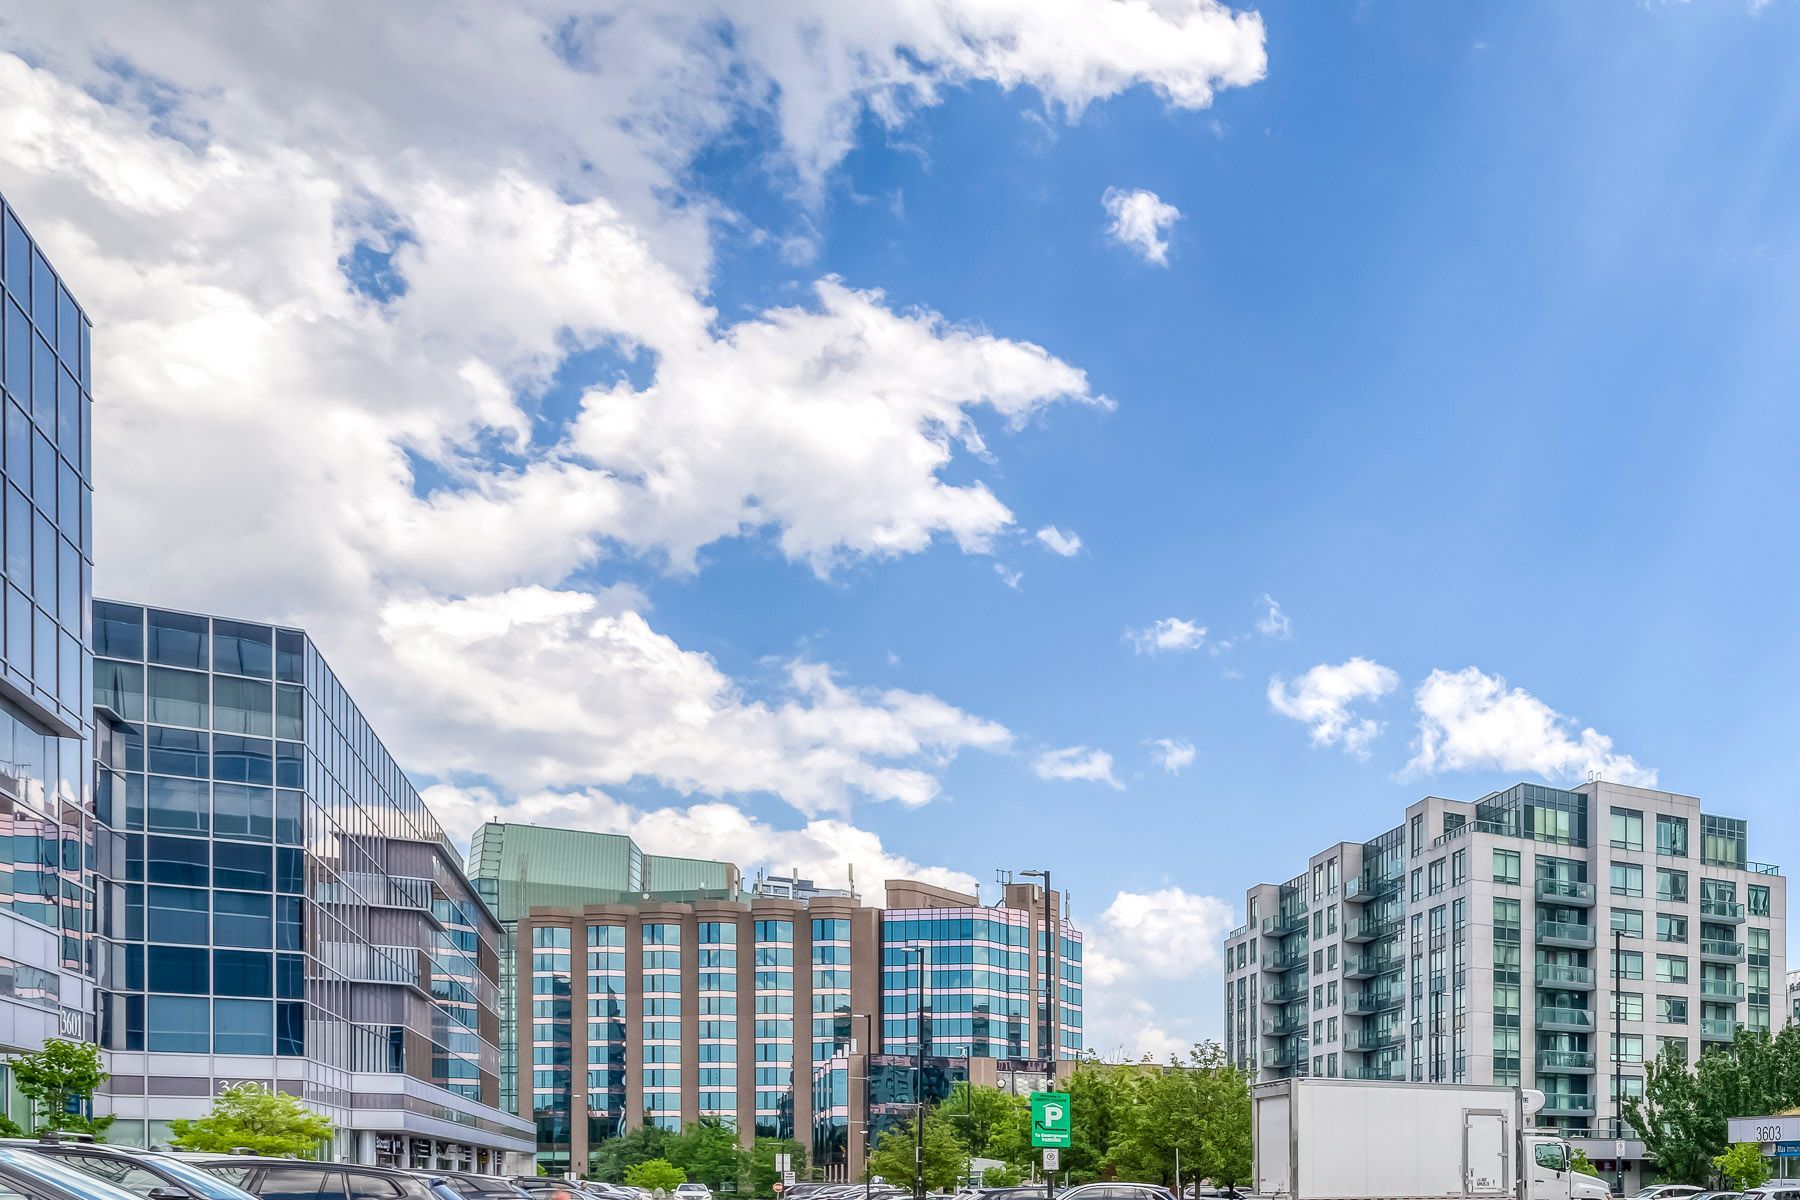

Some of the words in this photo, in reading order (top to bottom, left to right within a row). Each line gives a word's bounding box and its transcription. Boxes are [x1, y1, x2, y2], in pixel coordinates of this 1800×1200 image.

[61, 1010, 81, 1037] 3601
[1756, 1125, 1782, 1140] 3603
[1777, 1145, 1786, 1153] Max
